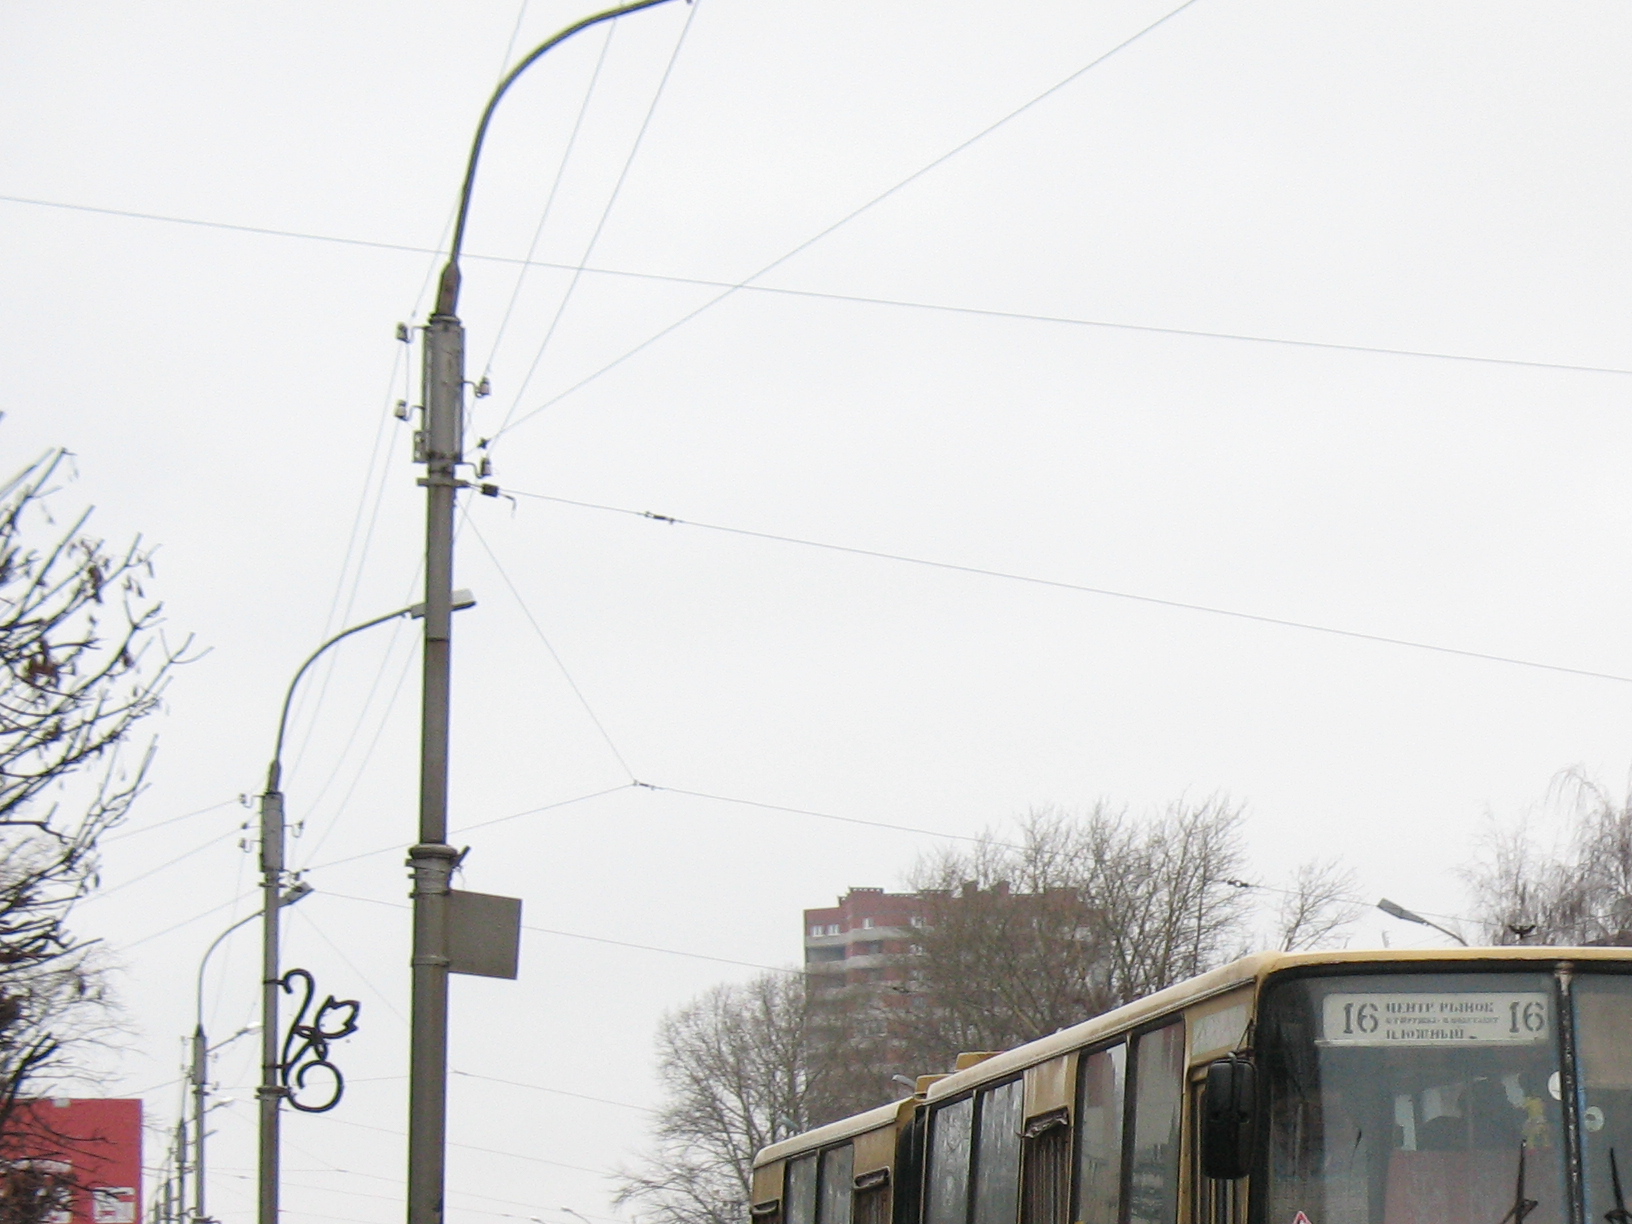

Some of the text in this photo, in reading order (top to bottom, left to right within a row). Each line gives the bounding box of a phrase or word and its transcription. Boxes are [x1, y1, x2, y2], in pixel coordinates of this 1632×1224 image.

[1343, 1002, 1378, 1034] 16
[1386, 1001, 1494, 1013] ЦЕНТР РЫНОК
[1509, 1001, 1545, 1033] 16
